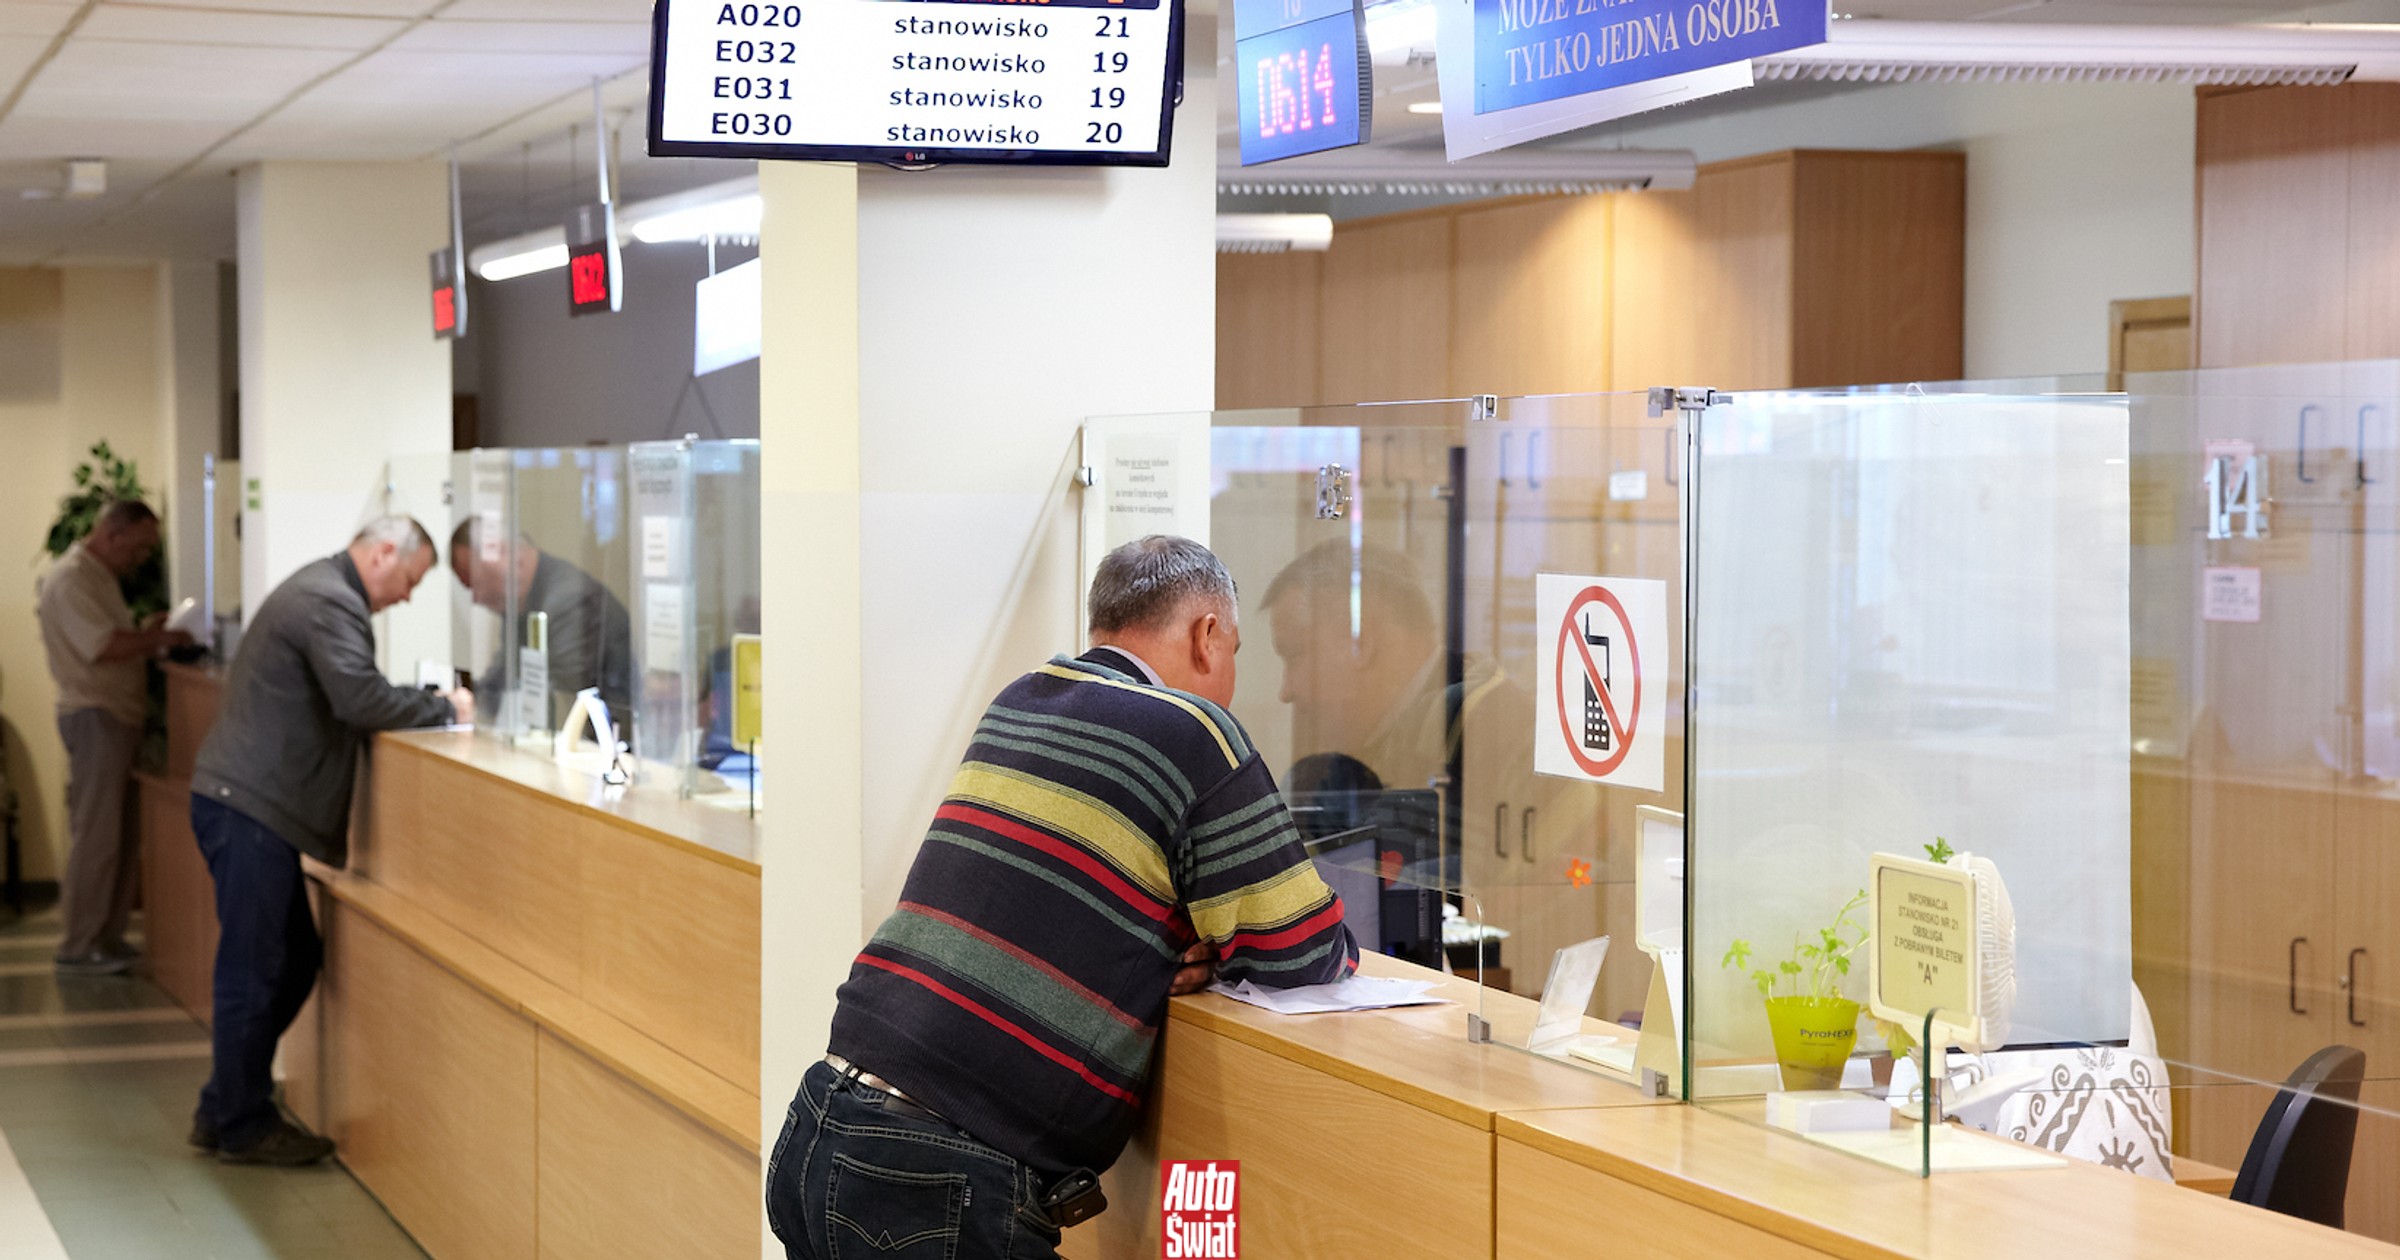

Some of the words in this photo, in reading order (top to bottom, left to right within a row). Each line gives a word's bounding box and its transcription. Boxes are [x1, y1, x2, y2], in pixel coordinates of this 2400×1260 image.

[717, 3, 802, 28] A020
[895, 16, 1049, 38] stanowisko
[1095, 15, 1130, 38] 21
[715, 40, 796, 64] E032
[892, 52, 1046, 74] stanowisko
[1093, 51, 1129, 73] 19
[1506, 31, 1591, 87] TYLKO
[1596, 11, 1681, 67] JEDNA
[1686, 0, 1780, 47] OSOBA
[714, 76, 792, 100] E031
[889, 88, 1043, 109] stanowisko
[1090, 87, 1126, 108] 19
[711, 112, 792, 136] E030
[887, 124, 1040, 145] stanowisko
[1086, 121, 1123, 144] 20
[2203, 456, 2262, 540] 14
[1898, 905, 1940, 926] STANOWISKO
[1941, 916, 1951, 928] NR
[1907, 892, 1949, 911] INFORMACJA
[1899, 937, 1934, 956] POBRANYM
[1935, 946, 1963, 965] BILETEM
